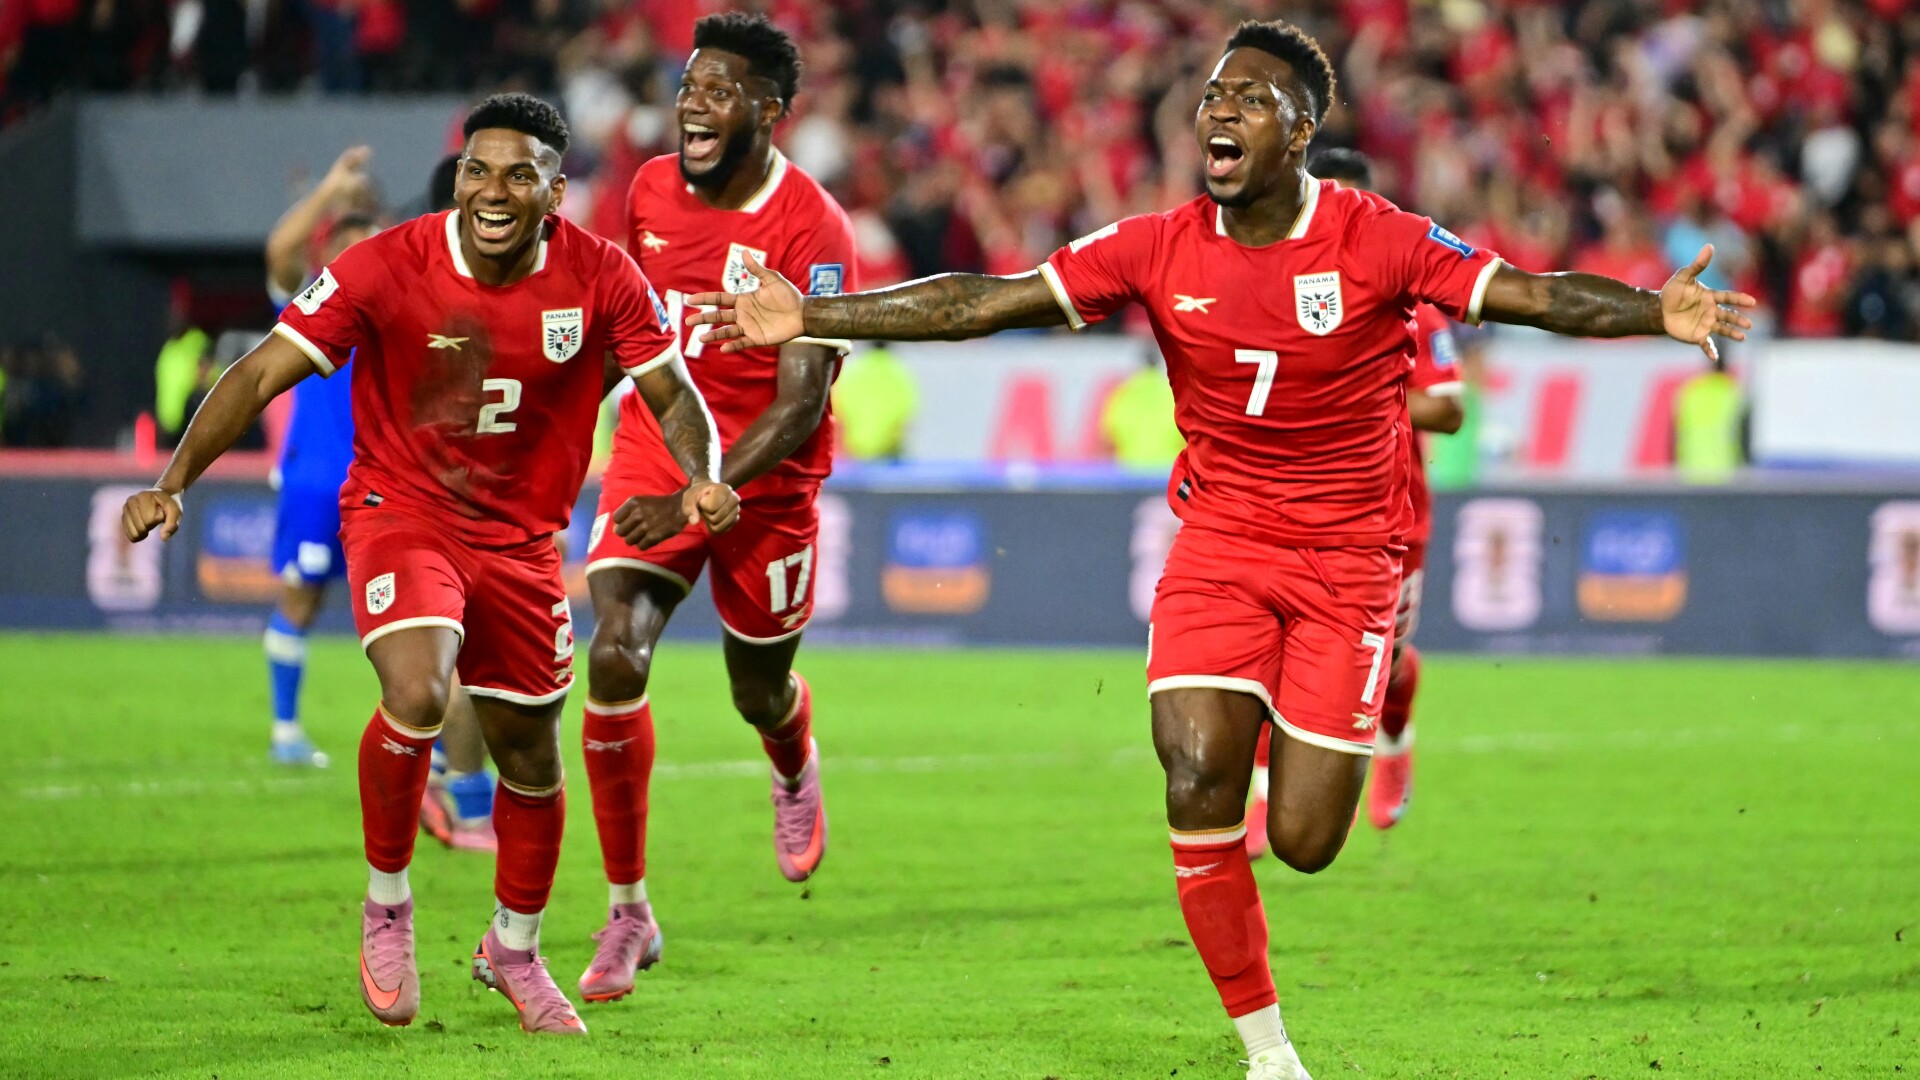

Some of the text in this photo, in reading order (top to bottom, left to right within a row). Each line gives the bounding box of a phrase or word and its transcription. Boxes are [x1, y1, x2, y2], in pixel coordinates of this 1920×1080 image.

[476, 378, 522, 433] 2
[1234, 348, 1278, 416] 7
[765, 543, 813, 614] 17
[552, 594, 574, 662] 2
[1361, 631, 1385, 705] 7
